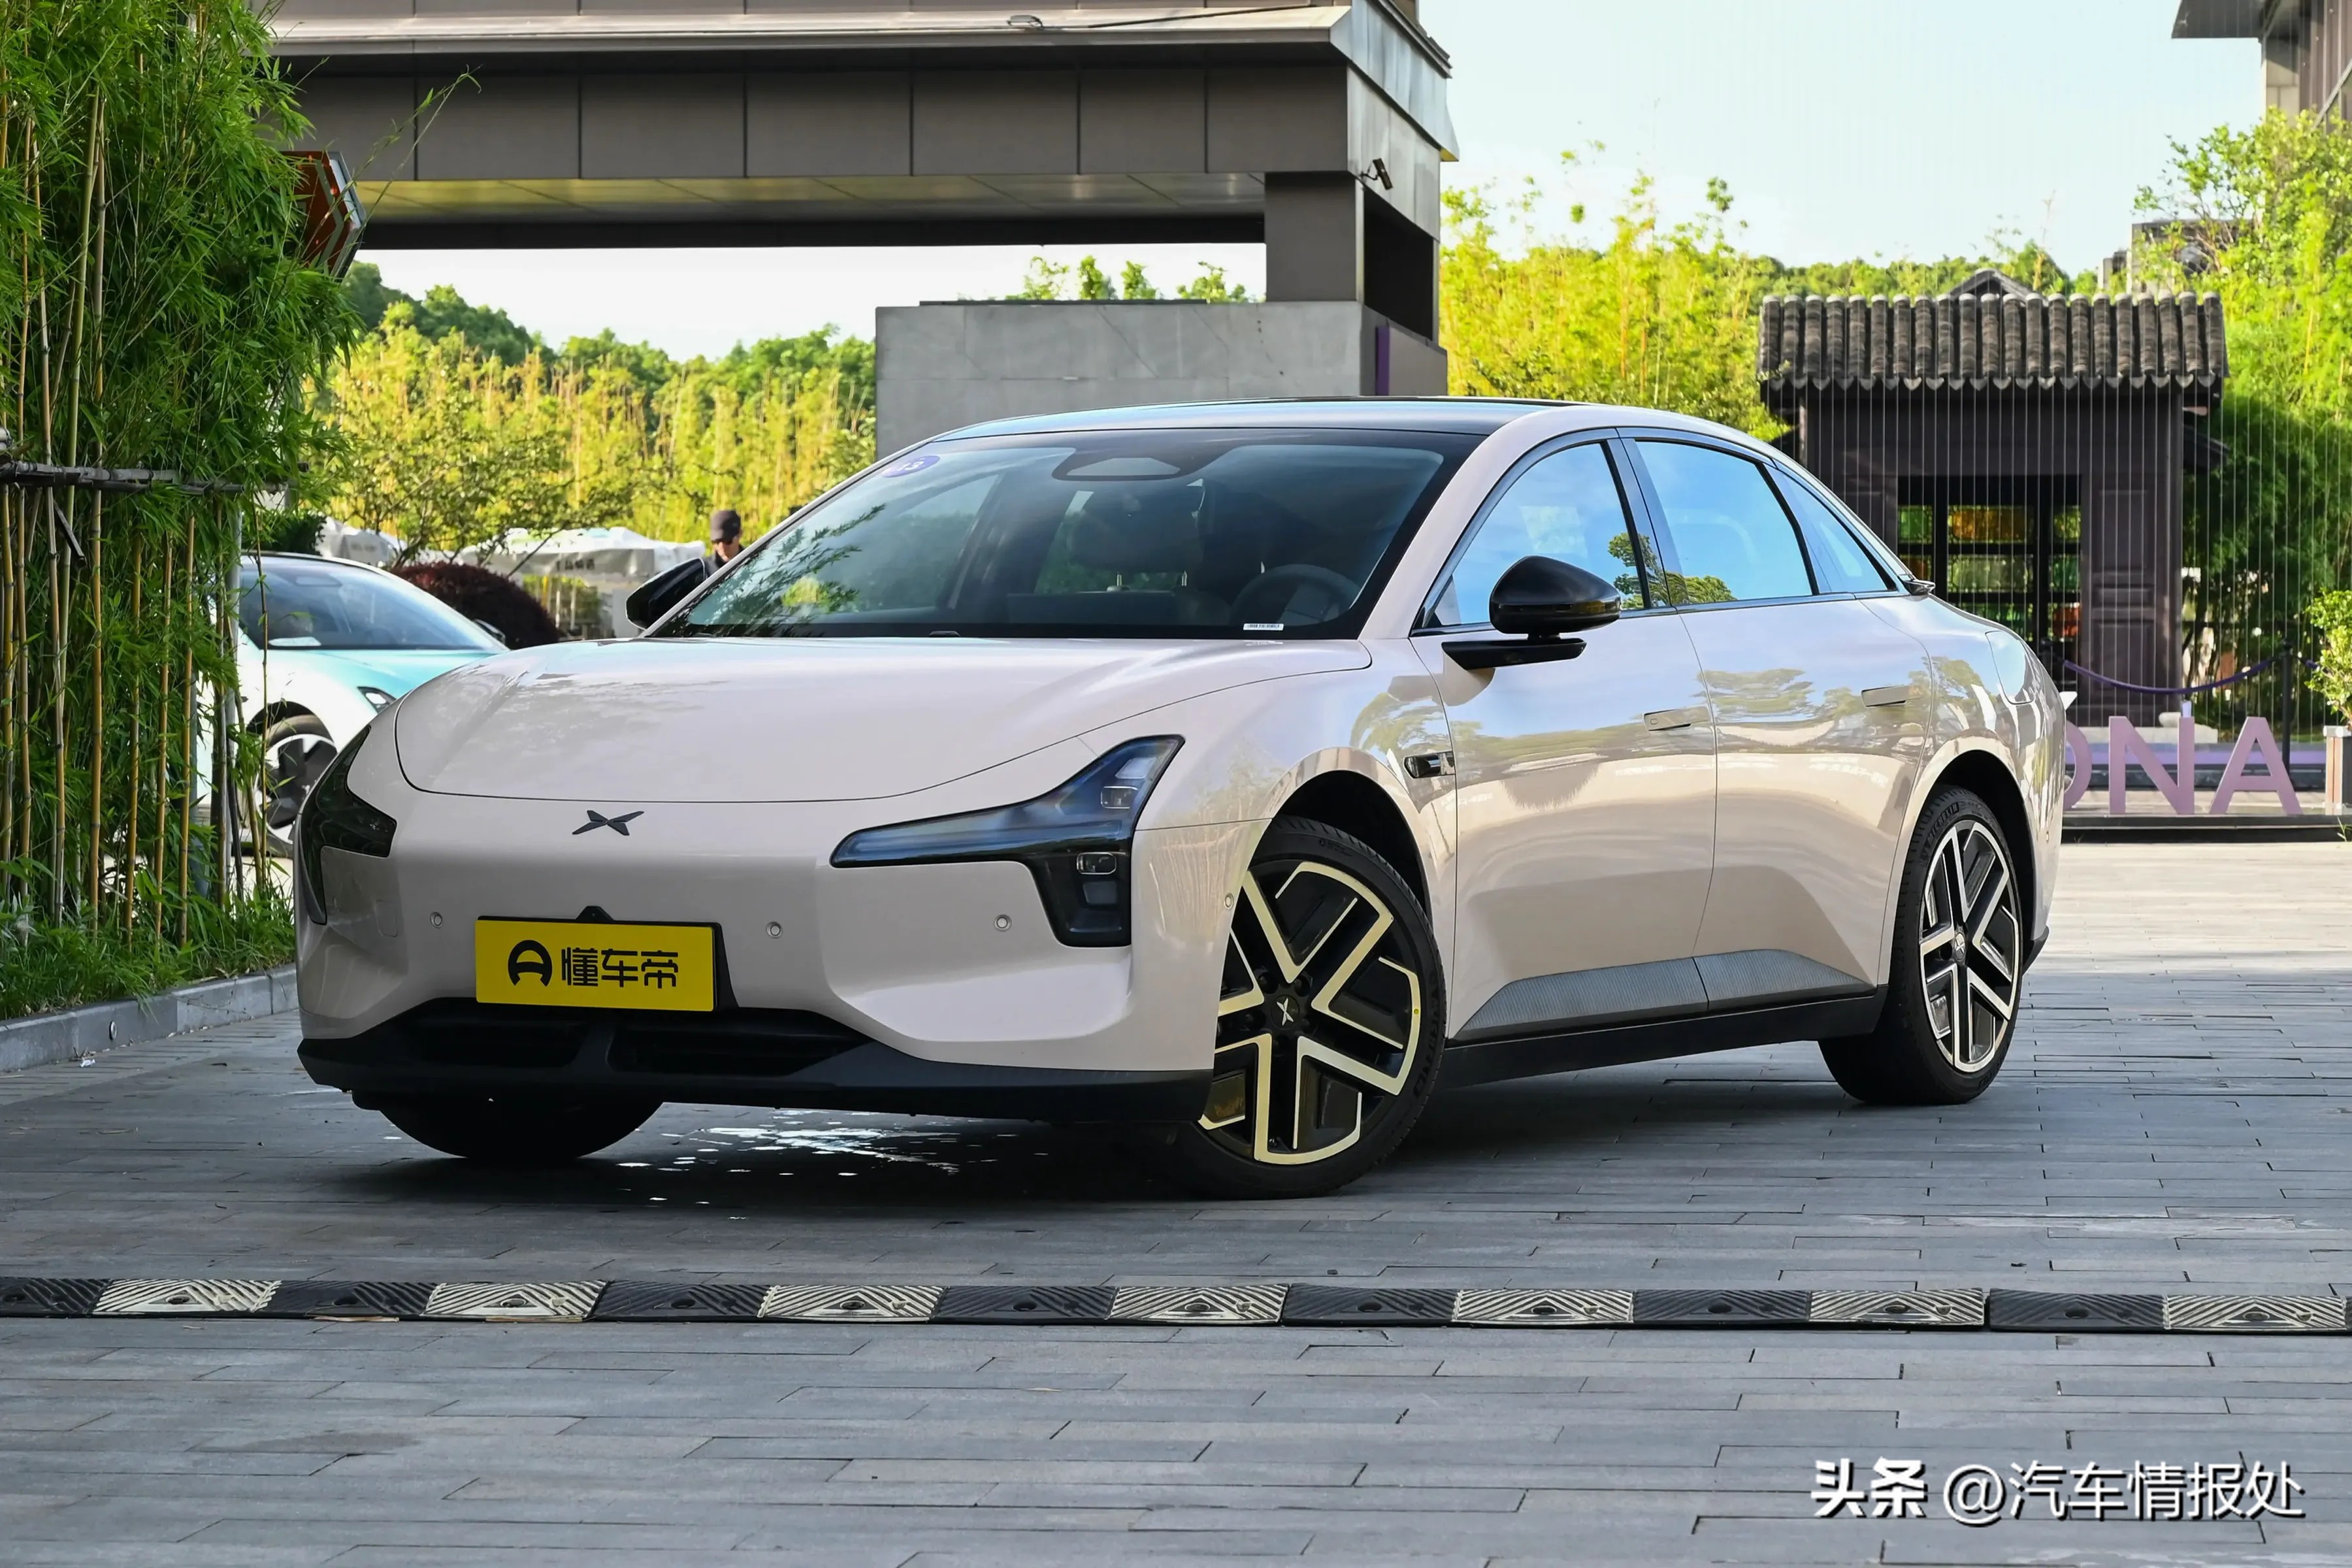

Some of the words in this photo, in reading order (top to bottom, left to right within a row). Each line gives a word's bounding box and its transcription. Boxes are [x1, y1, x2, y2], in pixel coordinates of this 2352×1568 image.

[2065, 715, 2304, 815] NA
[1927, 802, 1959, 845] MICHELIN
[561, 946, 679, 989] 懂车帝
